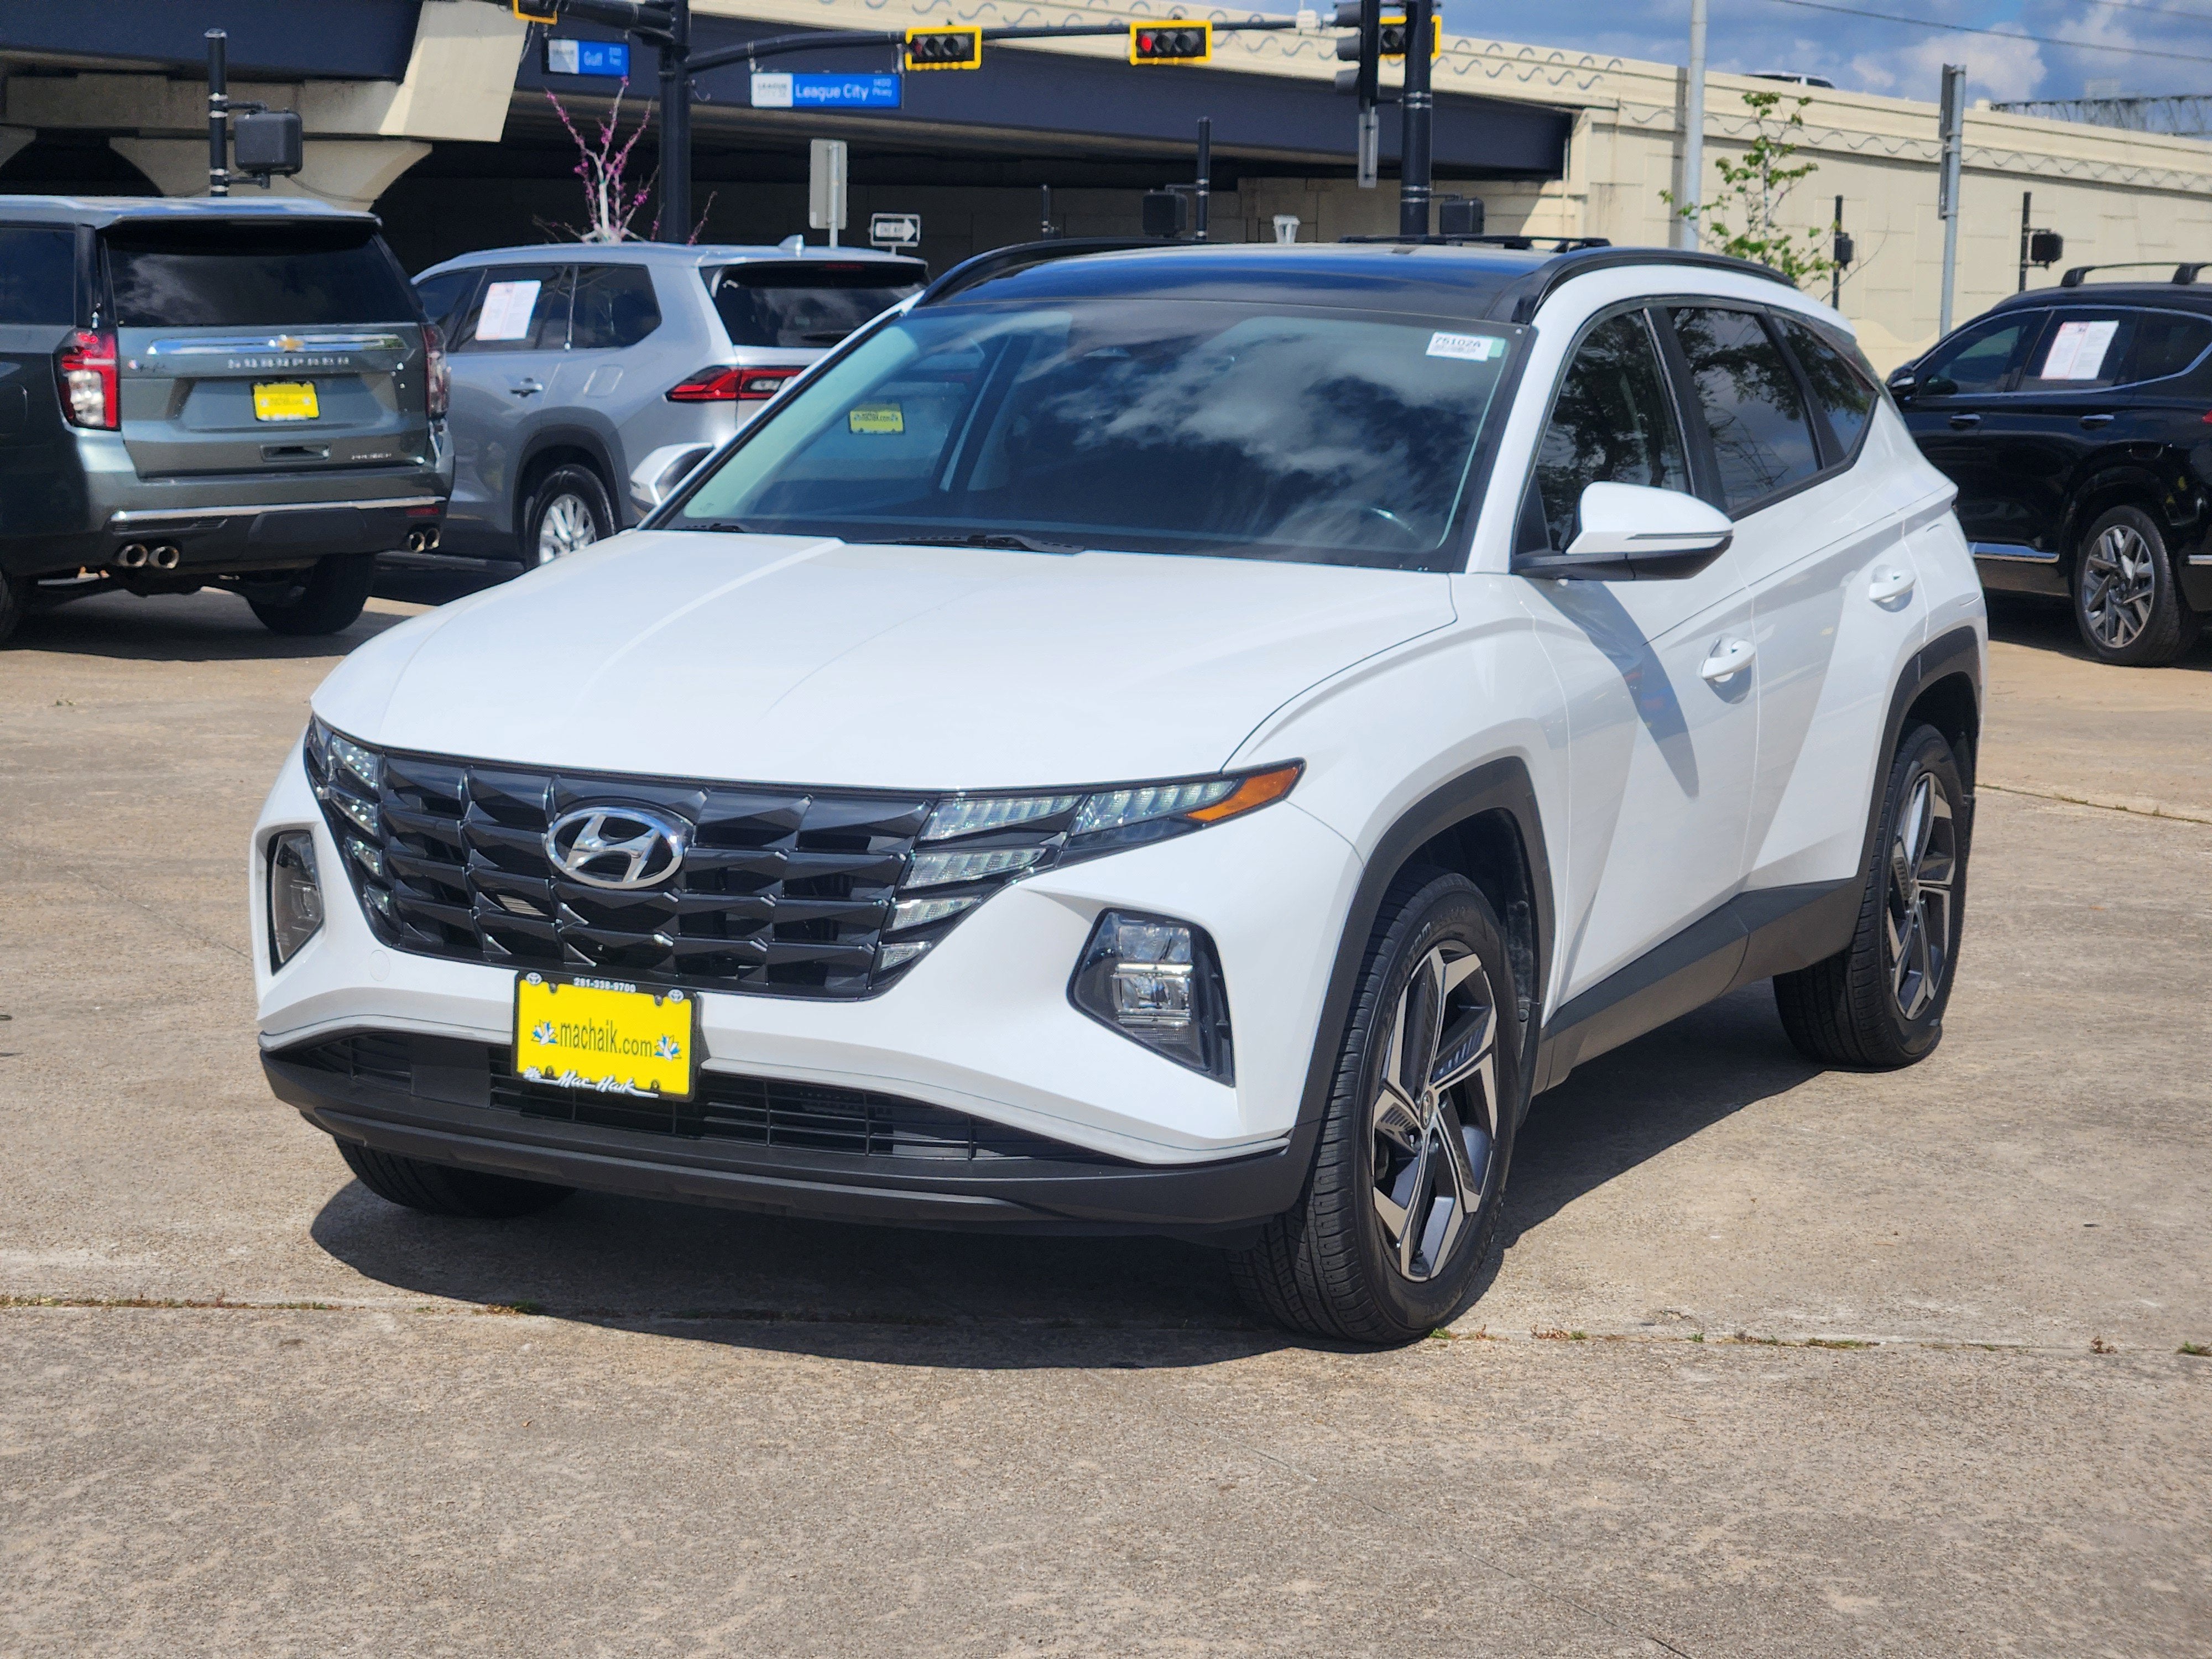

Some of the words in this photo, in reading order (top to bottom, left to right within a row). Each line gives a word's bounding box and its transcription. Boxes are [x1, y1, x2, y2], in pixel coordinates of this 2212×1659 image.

[795, 83, 841, 102] League
[843, 83, 869, 102] City
[560, 1018, 652, 1057] machaik.com
[555, 1069, 595, 1088] Mac
